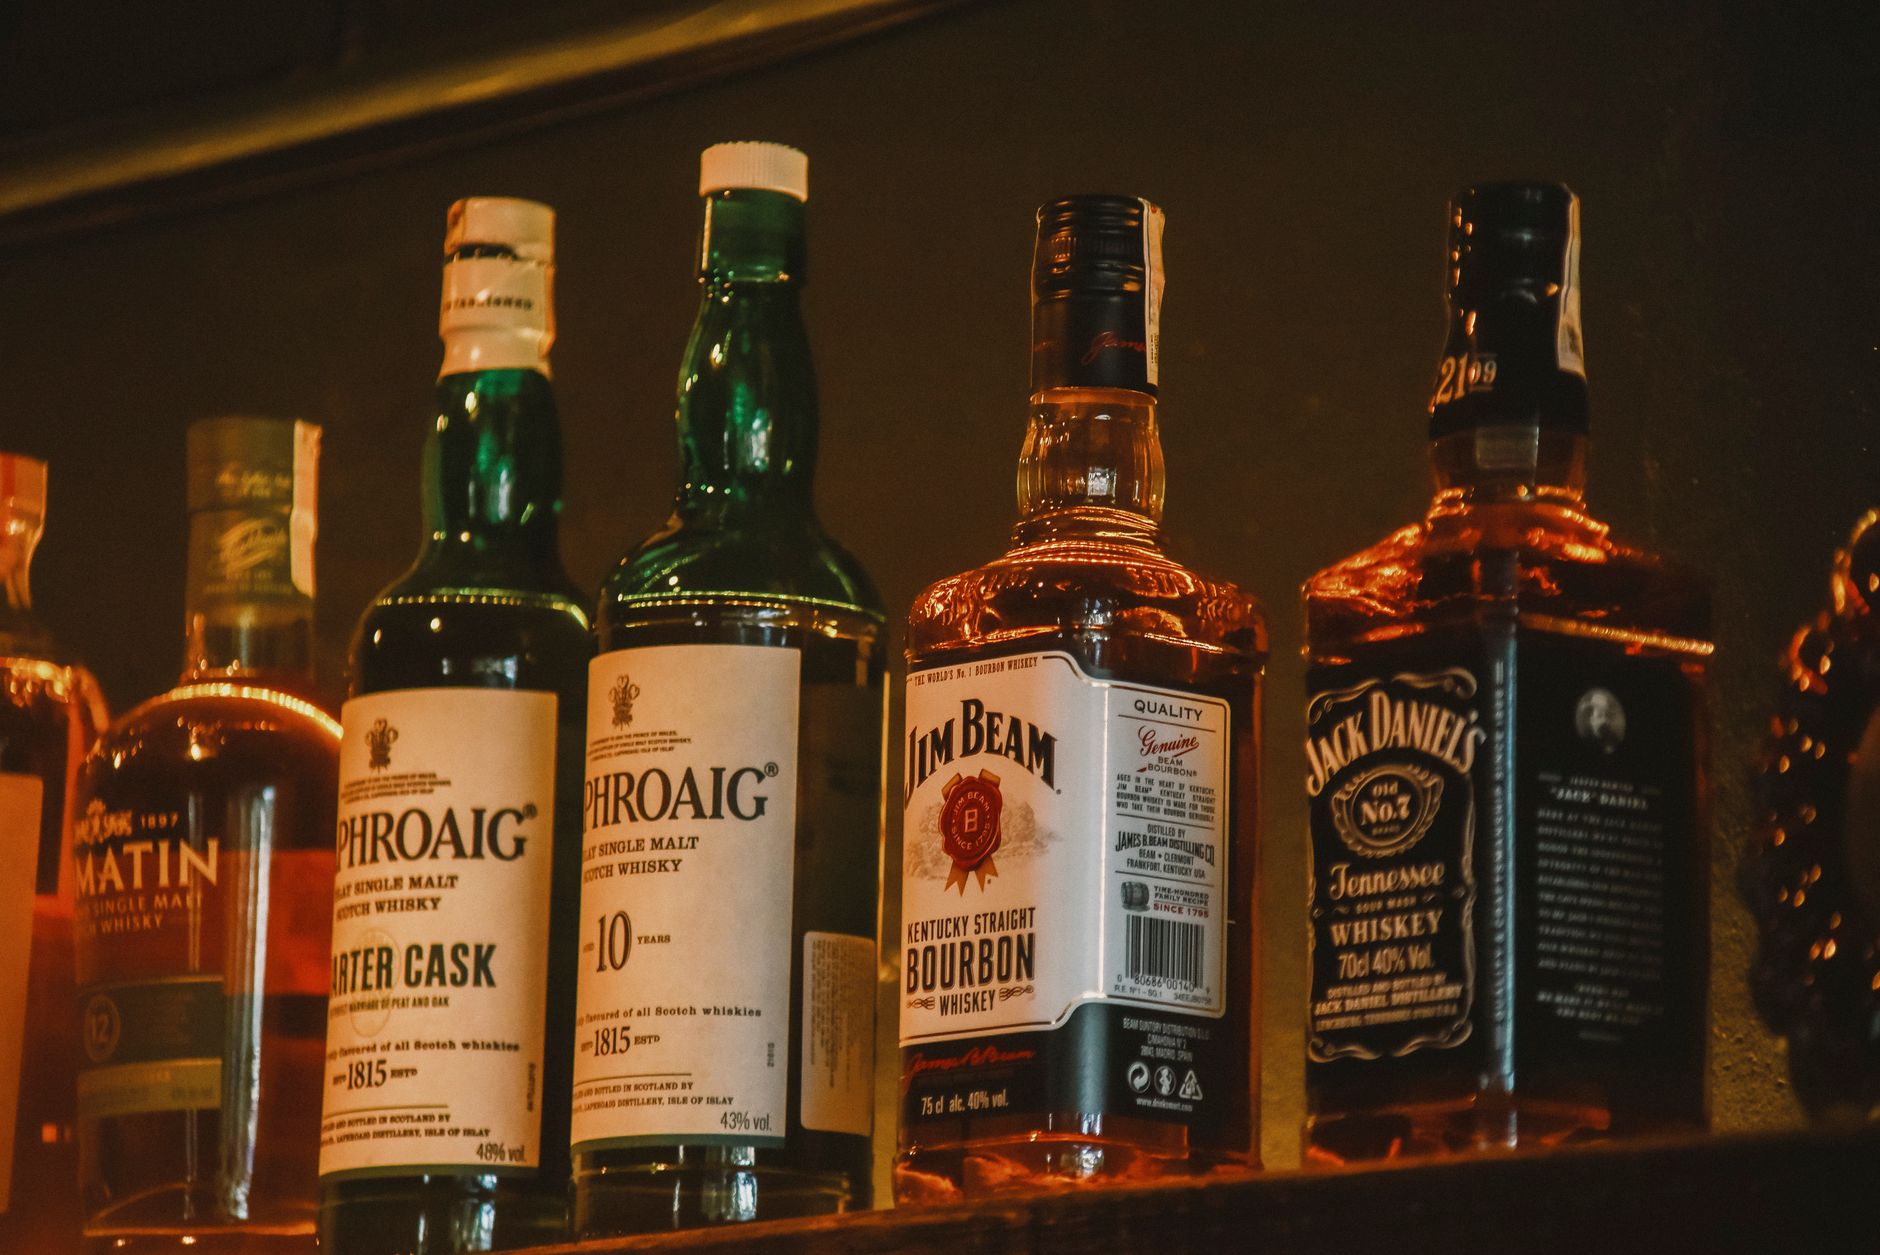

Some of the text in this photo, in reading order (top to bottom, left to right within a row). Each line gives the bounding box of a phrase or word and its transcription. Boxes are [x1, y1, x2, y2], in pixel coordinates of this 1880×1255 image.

[915, 675, 925, 687] THE
[927, 669, 954, 685] WORLD'S
[956, 668, 967, 679] No.
[975, 660, 1005, 676] BOURBON
[1007, 656, 1038, 671] WHISKEY
[1134, 699, 1203, 722] QUALITY
[1138, 725, 1200, 757] Genuine
[1306, 690, 1487, 797] JACK DANIEL'S
[904, 698, 1057, 810] JIM BEAM
[1158, 756, 1183, 767] BEAM
[1145, 778, 1154, 786] THE
[1159, 780, 1175, 789] HEART
[1160, 789, 1185, 799] KENTUCKY
[953, 791, 990, 817] JIM BEAM
[1117, 791, 1140, 801] BOURBON
[1117, 801, 1128, 809] WHO
[964, 809, 978, 833] B
[1147, 824, 1186, 838] DISTILLED BY
[599, 836, 699, 857] SINGLE MALT
[952, 825, 972, 850] SINCE
[1115, 831, 1204, 859] JAMES DISTILLING
[75, 837, 219, 897] MATIN
[618, 859, 682, 876] WHISKY
[1139, 849, 1194, 865] BEAM CLERMONT
[1163, 864, 1192, 876] KENTUCKY
[1194, 869, 1205, 879] USA
[1329, 863, 1445, 900] Tennessee
[354, 874, 459, 895] SINGLE MALT
[375, 897, 442, 914] WHISKY
[1155, 893, 1208, 906] FAMILY RECIPE
[1153, 903, 1209, 918] SINCE 1795
[101, 913, 163, 934] WHISKY
[907, 907, 1036, 944] KENTUCKY STRAIGHT
[1330, 909, 1444, 947] WHISKEY
[596, 910, 671, 973] 10 YEARS
[404, 942, 497, 988] CASK
[907, 933, 1036, 995] BOURBON
[1338, 942, 1437, 980] 70cl 40% Vol.
[391, 997, 410, 1008] PEAT
[412, 996, 430, 1008] AND
[431, 995, 449, 1008] OAK
[623, 1007, 633, 1018] of
[637, 1007, 651, 1017] all
[655, 1005, 697, 1016] Scotch
[702, 1005, 762, 1017] whiskies
[939, 989, 996, 1016] WHISKEY
[1314, 1000, 1342, 1016] JACK
[380, 1039, 520, 1051] of all Scotch whiskies
[593, 1025, 631, 1057] 1815
[634, 1035, 660, 1045] ESTD
[347, 1060, 387, 1090] 1815
[594, 1085, 622, 1095] BOTTLED
[623, 1083, 632, 1092] IN
[633, 1081, 678, 1092] SCOTLAND
[681, 1082, 694, 1091] BY
[617, 1096, 734, 1108] DISTILLERY, ISLE OF ISLAY
[921, 1089, 1010, 1116] 75 cl alc. 40% vol.
[390, 1114, 435, 1124] SCOTLAND
[438, 1114, 450, 1123] BY
[720, 1110, 772, 1132] 43% vol.
[424, 1128, 445, 1137] ISLE
[447, 1128, 460, 1137] OF
[463, 1128, 491, 1137] ISLAY
